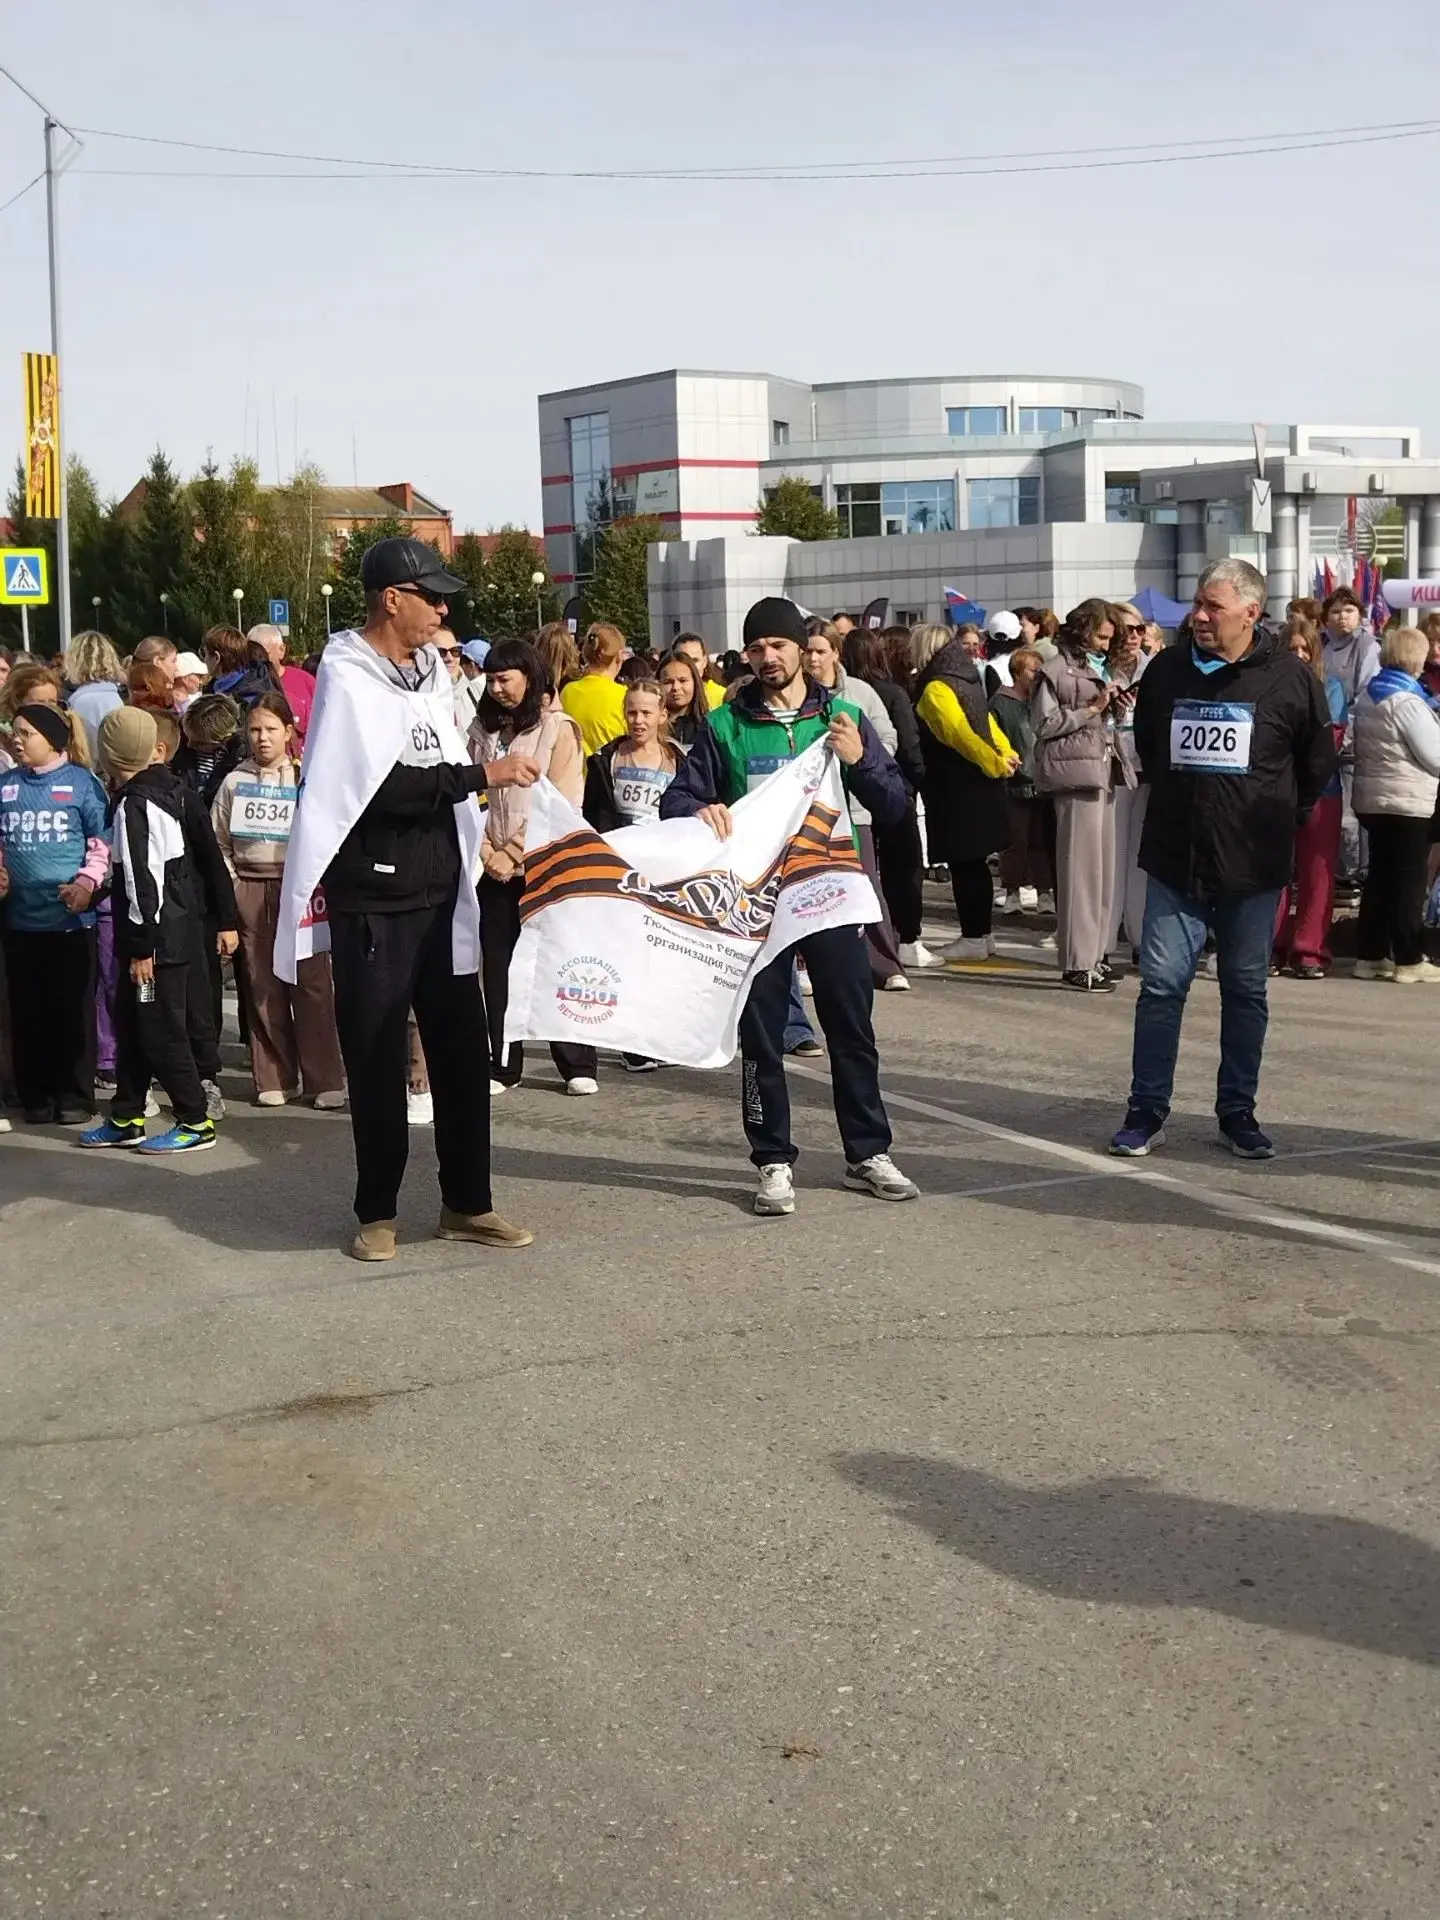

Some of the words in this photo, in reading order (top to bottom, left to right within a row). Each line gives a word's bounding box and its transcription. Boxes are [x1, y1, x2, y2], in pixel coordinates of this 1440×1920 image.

[274, 603, 284, 621] P
[1180, 725, 1237, 752] 2026
[622, 784, 661, 808] 6512
[244, 801, 289, 821] 6534
[646, 934, 724, 971] организация
[557, 956, 623, 984] АССОЦИАЦИЯ
[557, 1002, 614, 1025] ВЕТЕРАНОВ
